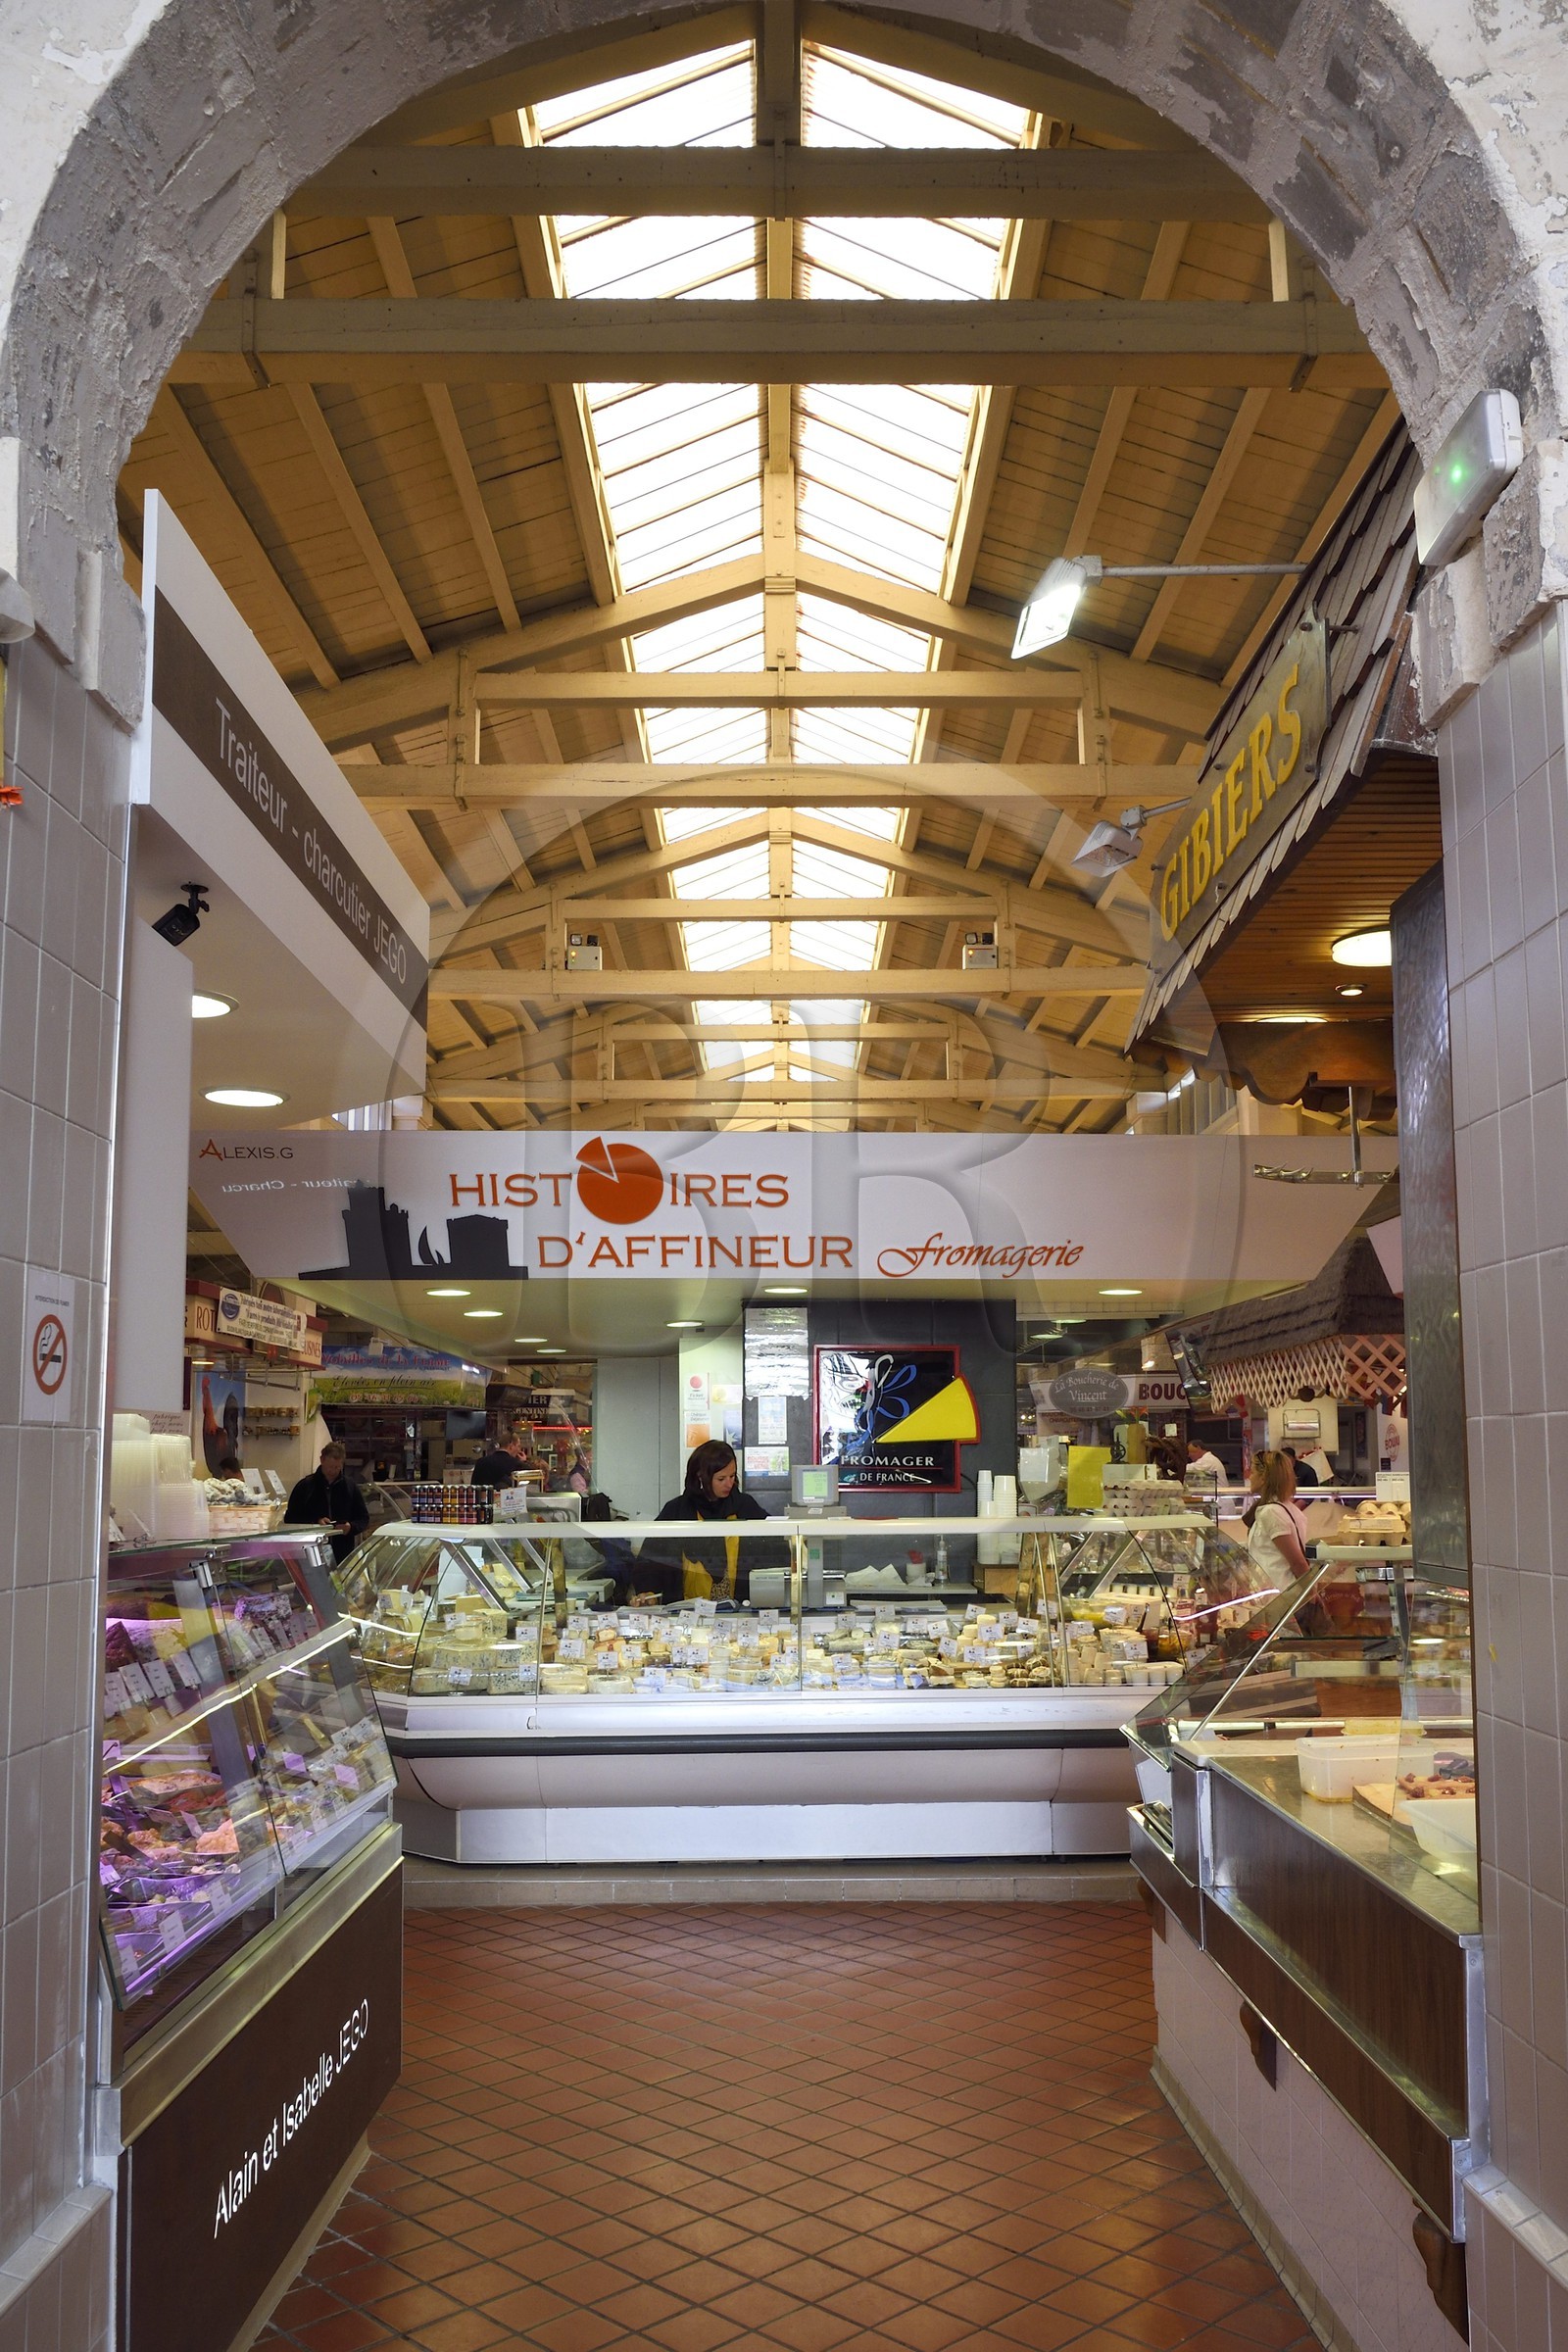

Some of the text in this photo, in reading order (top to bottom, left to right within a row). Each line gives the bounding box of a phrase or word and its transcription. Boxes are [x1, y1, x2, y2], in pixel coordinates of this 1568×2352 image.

[1160, 663, 1301, 942] GIBIERS
[215, 697, 288, 834] Traiteur
[304, 827, 371, 940] charcutier
[373, 914, 407, 985] JEGO
[536, 1231, 855, 1269] D'AFFINEUR
[1068, 1390, 1108, 1401] Vincent
[840, 1455, 935, 1466] FROMAGER
[859, 1472, 915, 1482] DE FRANCE
[214, 1997, 369, 2240] Alain et Isabelle JEGO
